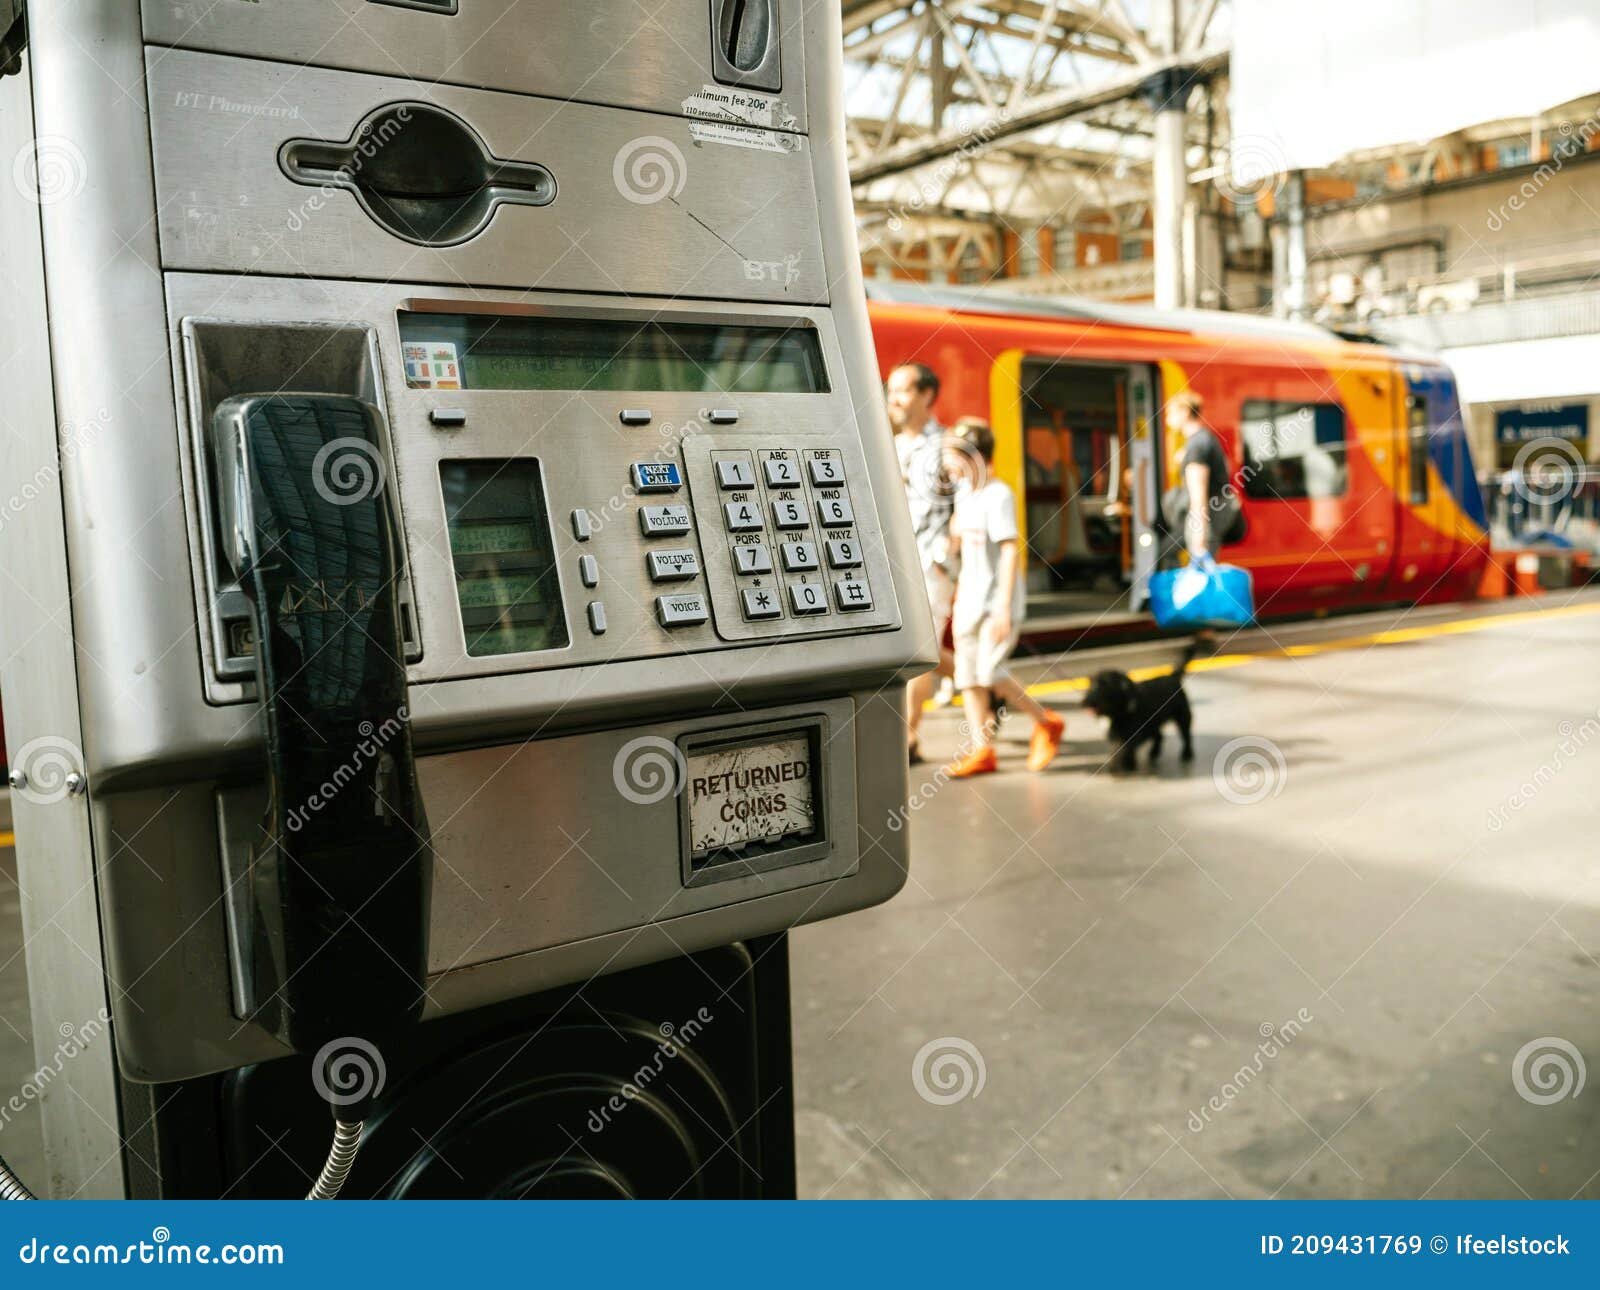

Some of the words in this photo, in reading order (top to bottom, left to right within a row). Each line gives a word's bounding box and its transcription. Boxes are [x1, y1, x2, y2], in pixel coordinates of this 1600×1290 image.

[730, 94, 746, 106] fee
[770, 451, 788, 460] ABC
[814, 451, 830, 460] DEF
[644, 464, 670, 474] NEXT
[732, 464, 742, 481] 1
[778, 463, 790, 480] 2
[821, 462, 835, 478] 3
[647, 474, 673, 484] CALL
[732, 493, 748, 502] GHI
[778, 491, 795, 501] JKL
[821, 490, 840, 500] MNO
[739, 506, 752, 523] 4
[786, 504, 798, 521] 5
[831, 502, 843, 518] 6
[650, 516, 689, 526] VOLUME
[735, 534, 761, 544] PQRS
[786, 533, 803, 542] TUV
[827, 530, 852, 540] WXYZ
[795, 546, 807, 563] 8
[840, 543, 852, 560] 9
[656, 554, 695, 565] VOLUME
[746, 549, 757, 567] 7
[804, 588, 816, 605] 0
[671, 601, 701, 612] VOICE
[692, 760, 808, 798] RETURNED
[720, 793, 787, 822] COINS
